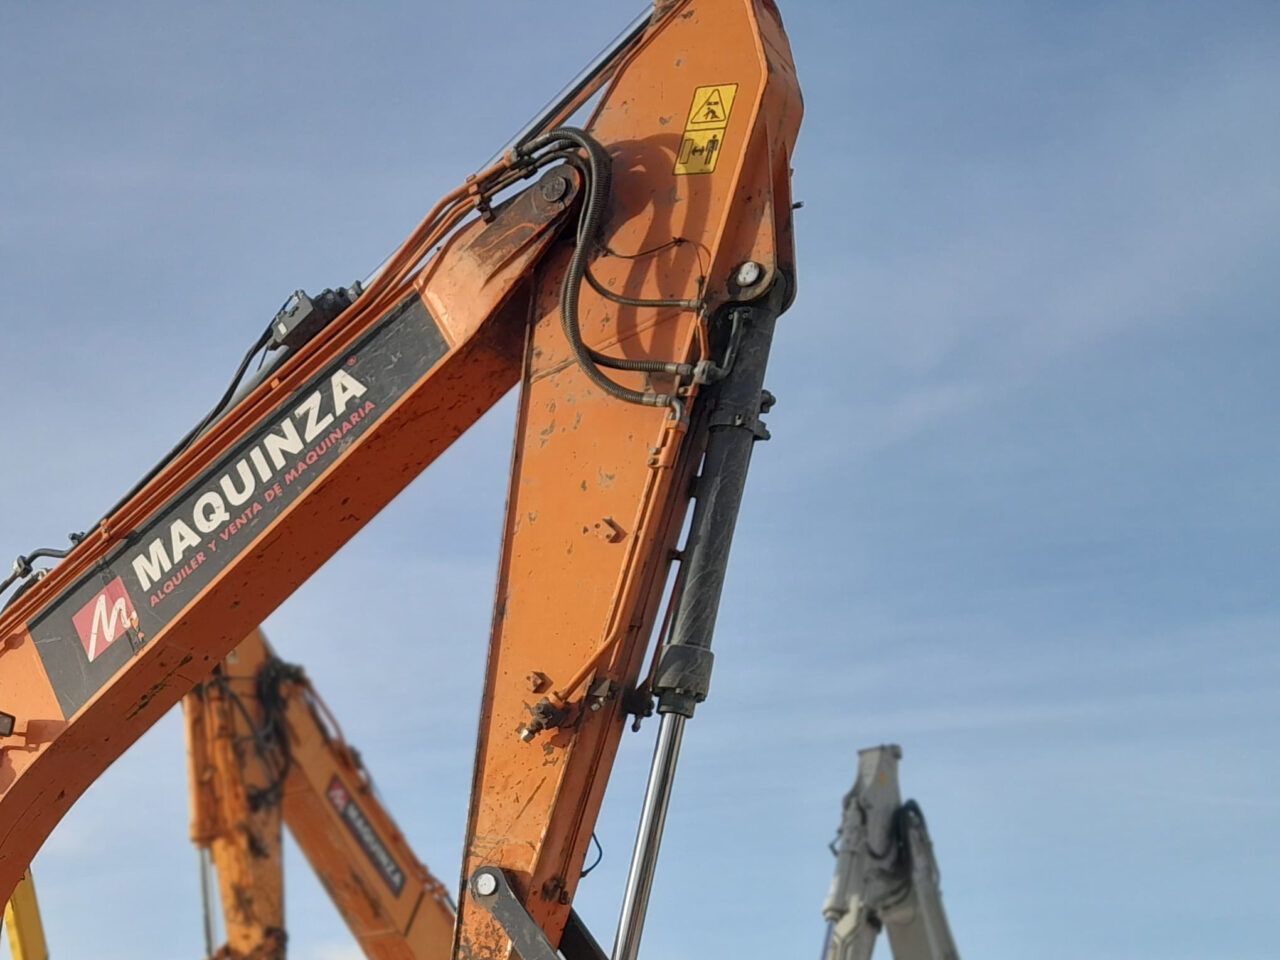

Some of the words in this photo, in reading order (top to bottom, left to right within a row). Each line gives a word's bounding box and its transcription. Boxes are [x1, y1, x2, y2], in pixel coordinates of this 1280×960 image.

[131, 368, 368, 593] MAQUINZA
[149, 550, 207, 608] ALQUILER
[207, 539, 218, 552] Y
[219, 501, 263, 541] VENTA
[263, 482, 284, 503] DE
[284, 400, 377, 486] MAQUINARIA
